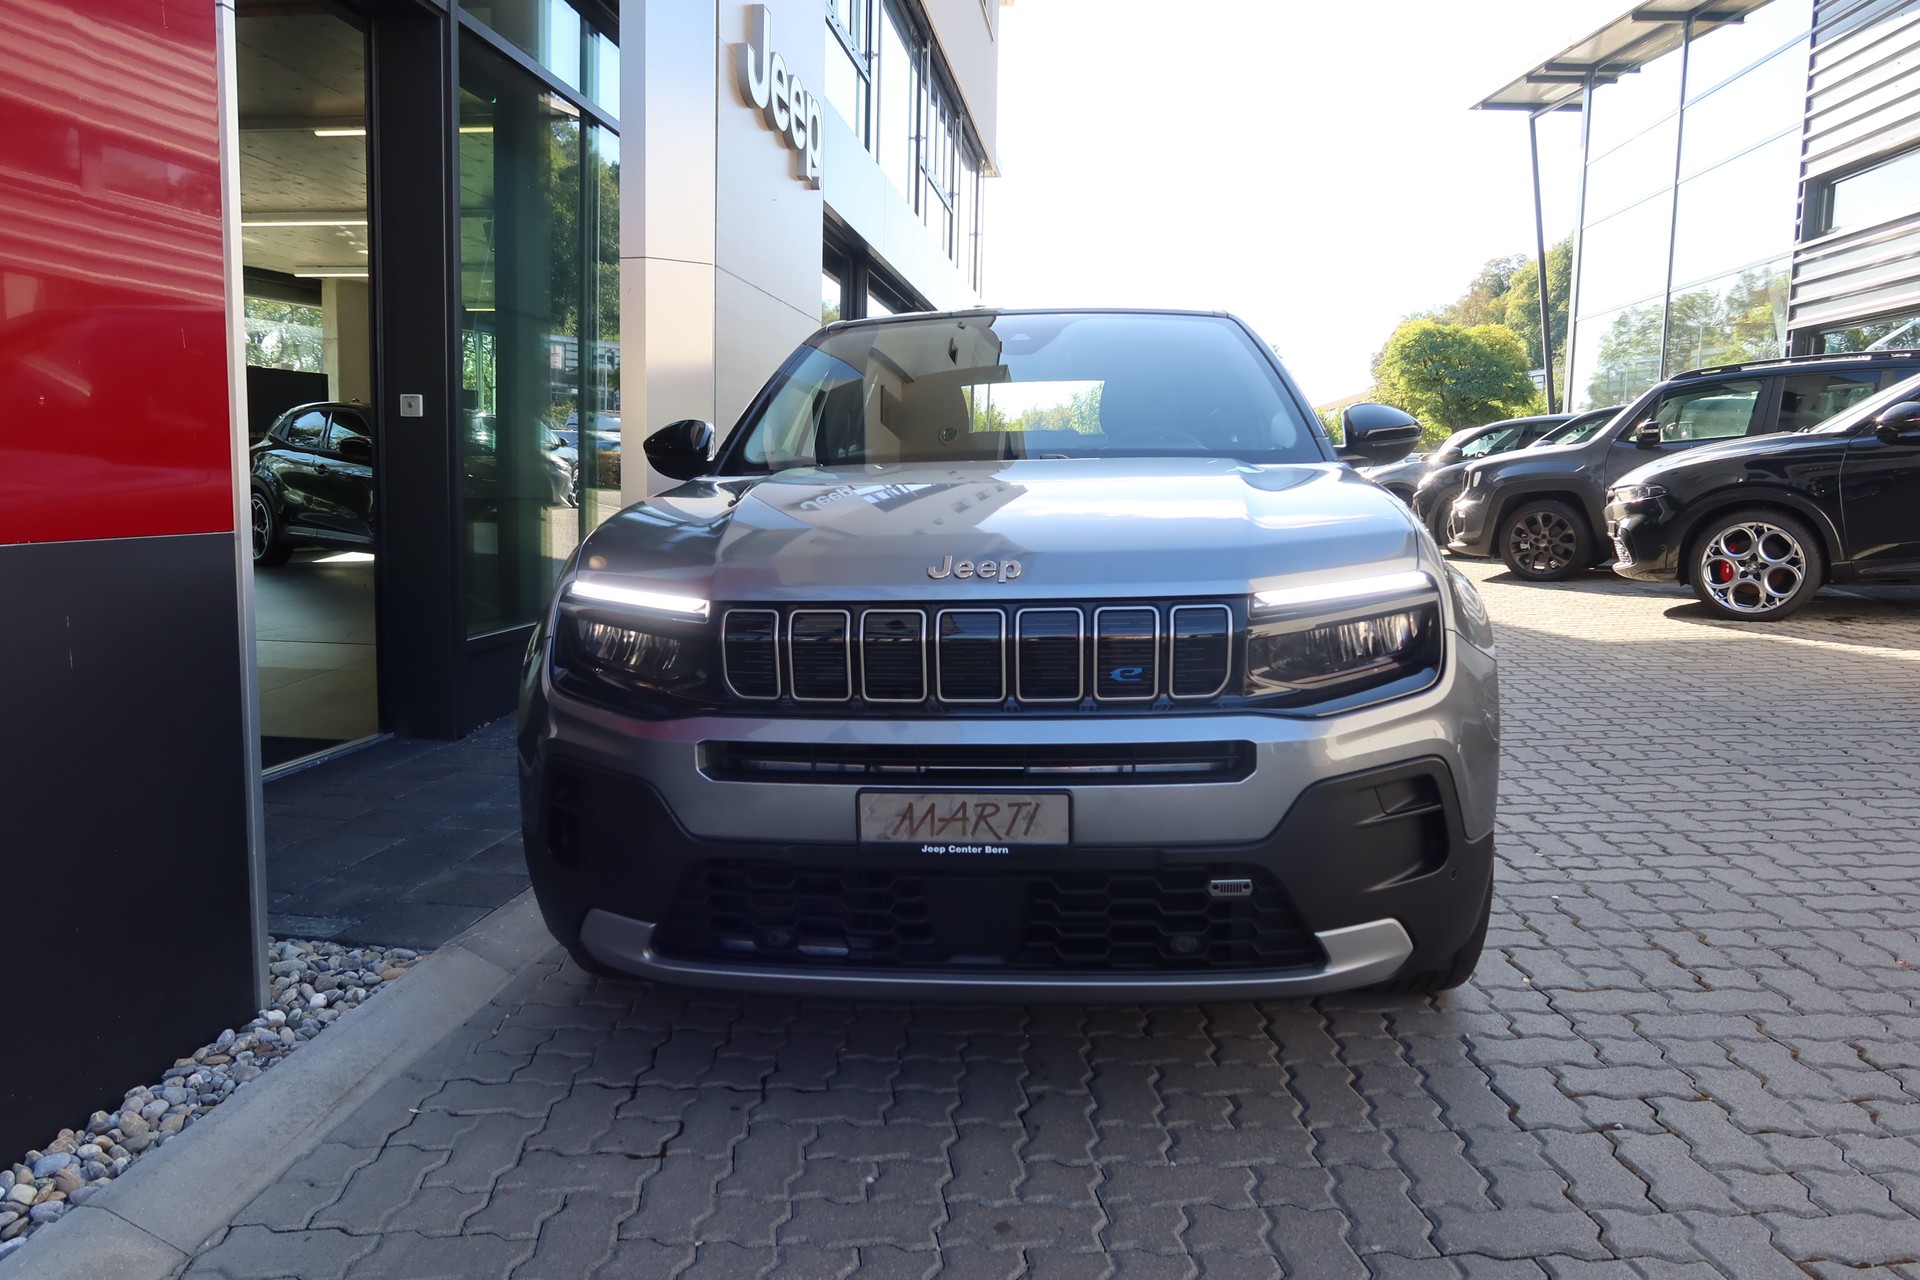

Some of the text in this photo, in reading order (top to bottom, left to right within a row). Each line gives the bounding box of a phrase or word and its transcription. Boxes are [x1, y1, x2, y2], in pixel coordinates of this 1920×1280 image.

[736, 4, 823, 182] Jeep
[927, 555, 1022, 583] Jeep
[891, 801, 1040, 841] MARTI
[921, 844, 1009, 855] Jeep Center Bern
